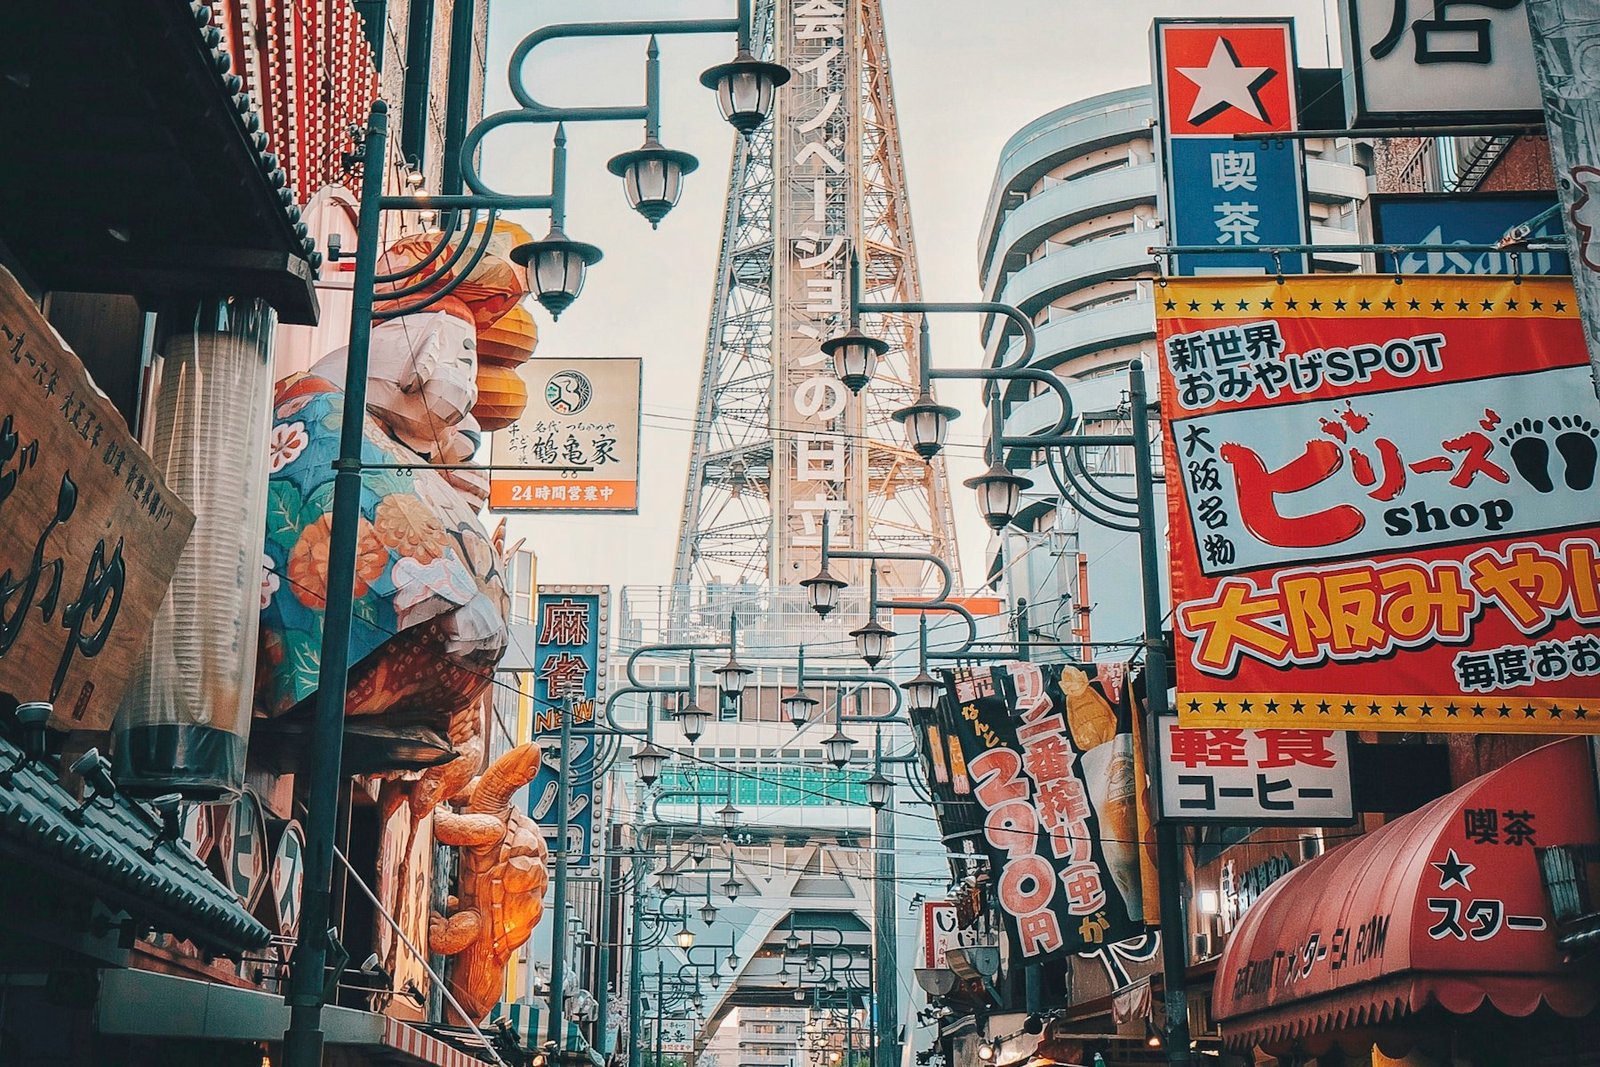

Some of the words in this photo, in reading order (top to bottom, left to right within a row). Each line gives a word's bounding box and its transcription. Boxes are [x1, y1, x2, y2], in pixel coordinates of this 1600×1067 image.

[1210, 150, 1261, 246] 喫茶
[1169, 323, 1283, 373] 新世界
[1179, 336, 1445, 407] おみやげSPOT
[532, 433, 620, 465] 鶴亀家
[511, 485, 614, 502] 24時間営業中
[1183, 423, 1236, 567] 大阪名物
[1219, 400, 1510, 548] ビリーズ
[539, 598, 591, 700] 麻雀
[1169, 725, 1337, 769] 軽食
[1178, 773, 1334, 811] コーヒー
[1464, 808, 1537, 848] 喫茶
[1426, 897, 1548, 943] スター
